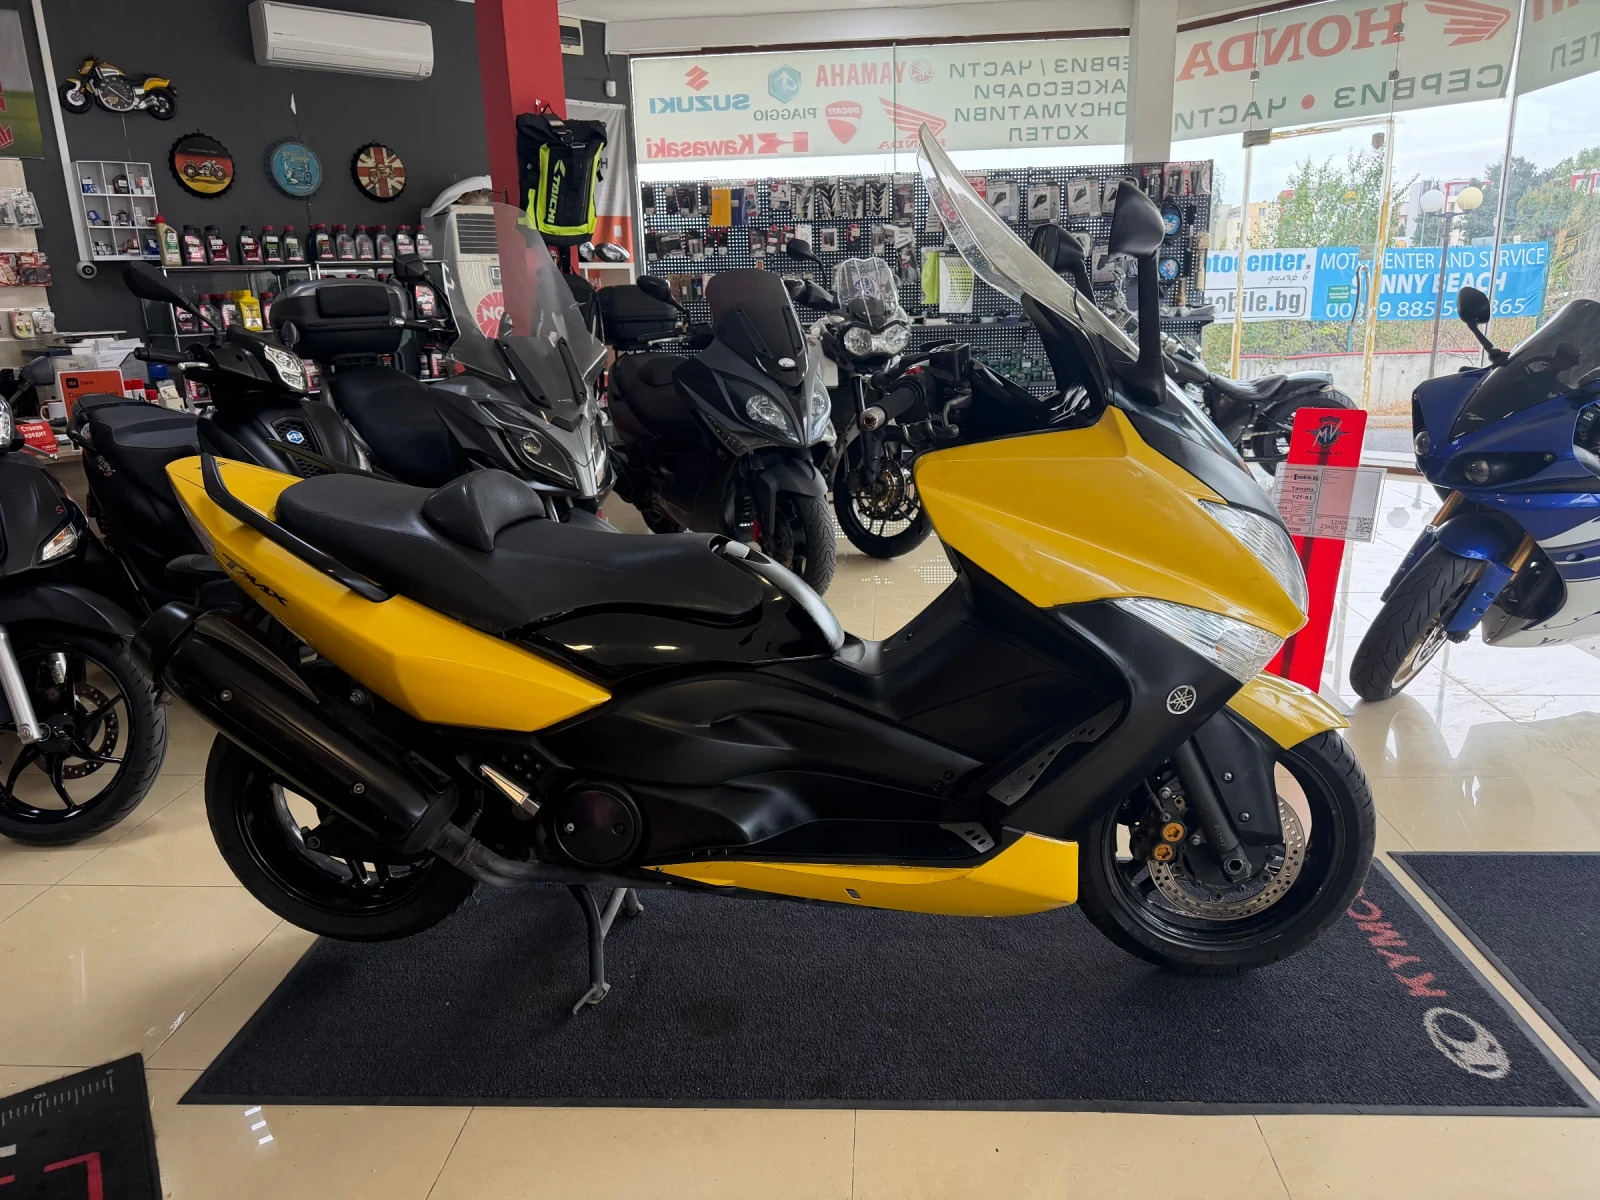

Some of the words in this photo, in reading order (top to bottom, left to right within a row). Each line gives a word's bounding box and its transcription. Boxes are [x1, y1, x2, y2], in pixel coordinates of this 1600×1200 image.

[546, 174, 561, 224] TAICHI
[1320, 252, 1370, 270] MOT
[1381, 252, 1434, 269] ENTER
[1351, 273, 1429, 295] SNNY
[1432, 271, 1508, 294] BEACH
[1325, 301, 1392, 318] 009
[1396, 300, 1435, 318] 885
[1346, 888, 1448, 997] KYMC
